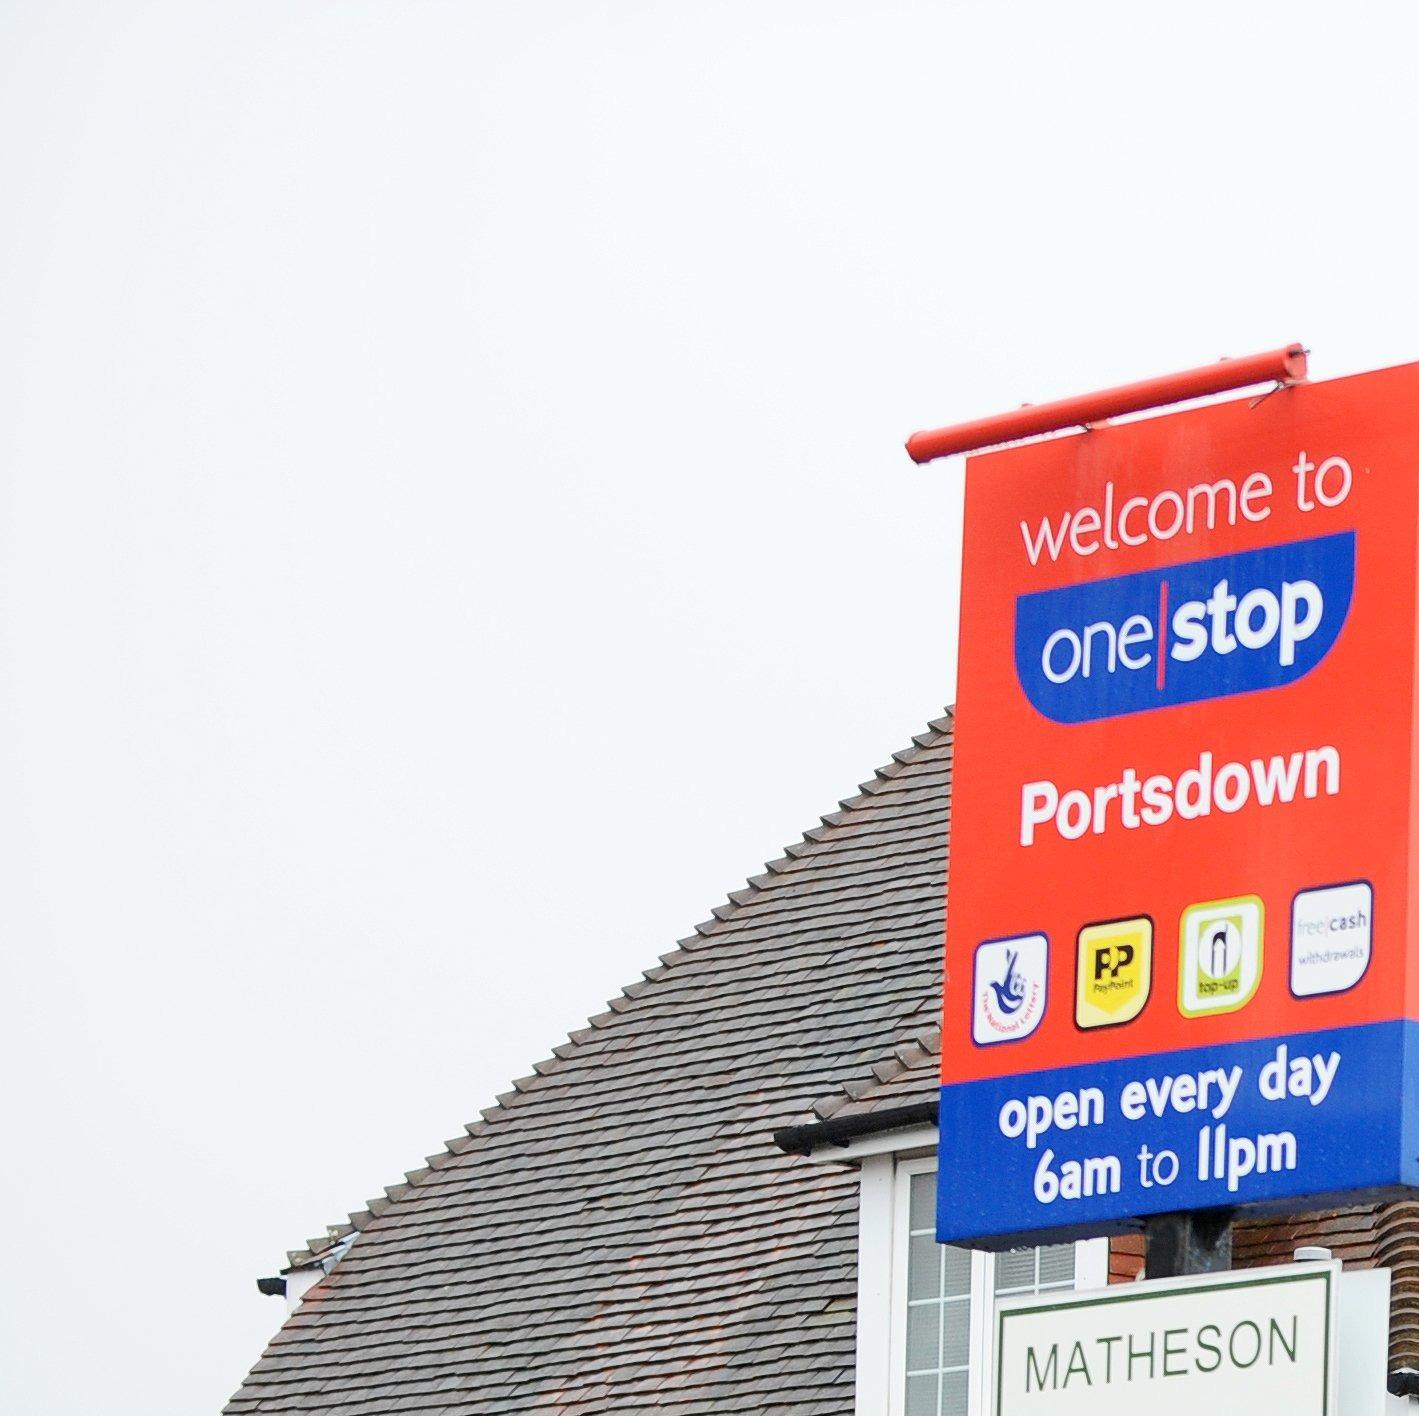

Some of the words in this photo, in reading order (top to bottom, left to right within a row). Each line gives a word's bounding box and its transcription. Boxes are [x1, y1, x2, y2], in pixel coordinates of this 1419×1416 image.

[1020, 473, 1273, 567] welcome
[1292, 452, 1353, 513] to
[1041, 615, 1154, 685] one
[1170, 579, 1324, 666] stop
[1019, 745, 1341, 847] Portsdown
[1298, 944, 1365, 965] withdrawals
[1329, 911, 1367, 933] cash
[1200, 978, 1239, 996] top-up
[999, 1085, 1105, 1149] open
[1120, 1064, 1243, 1121] every
[1258, 1043, 1341, 1107] day
[1034, 1148, 1121, 1205] 6am
[1138, 1142, 1180, 1188] to
[1198, 1124, 1297, 1192] 11pm
[1025, 1315, 1298, 1393] MATHESON
